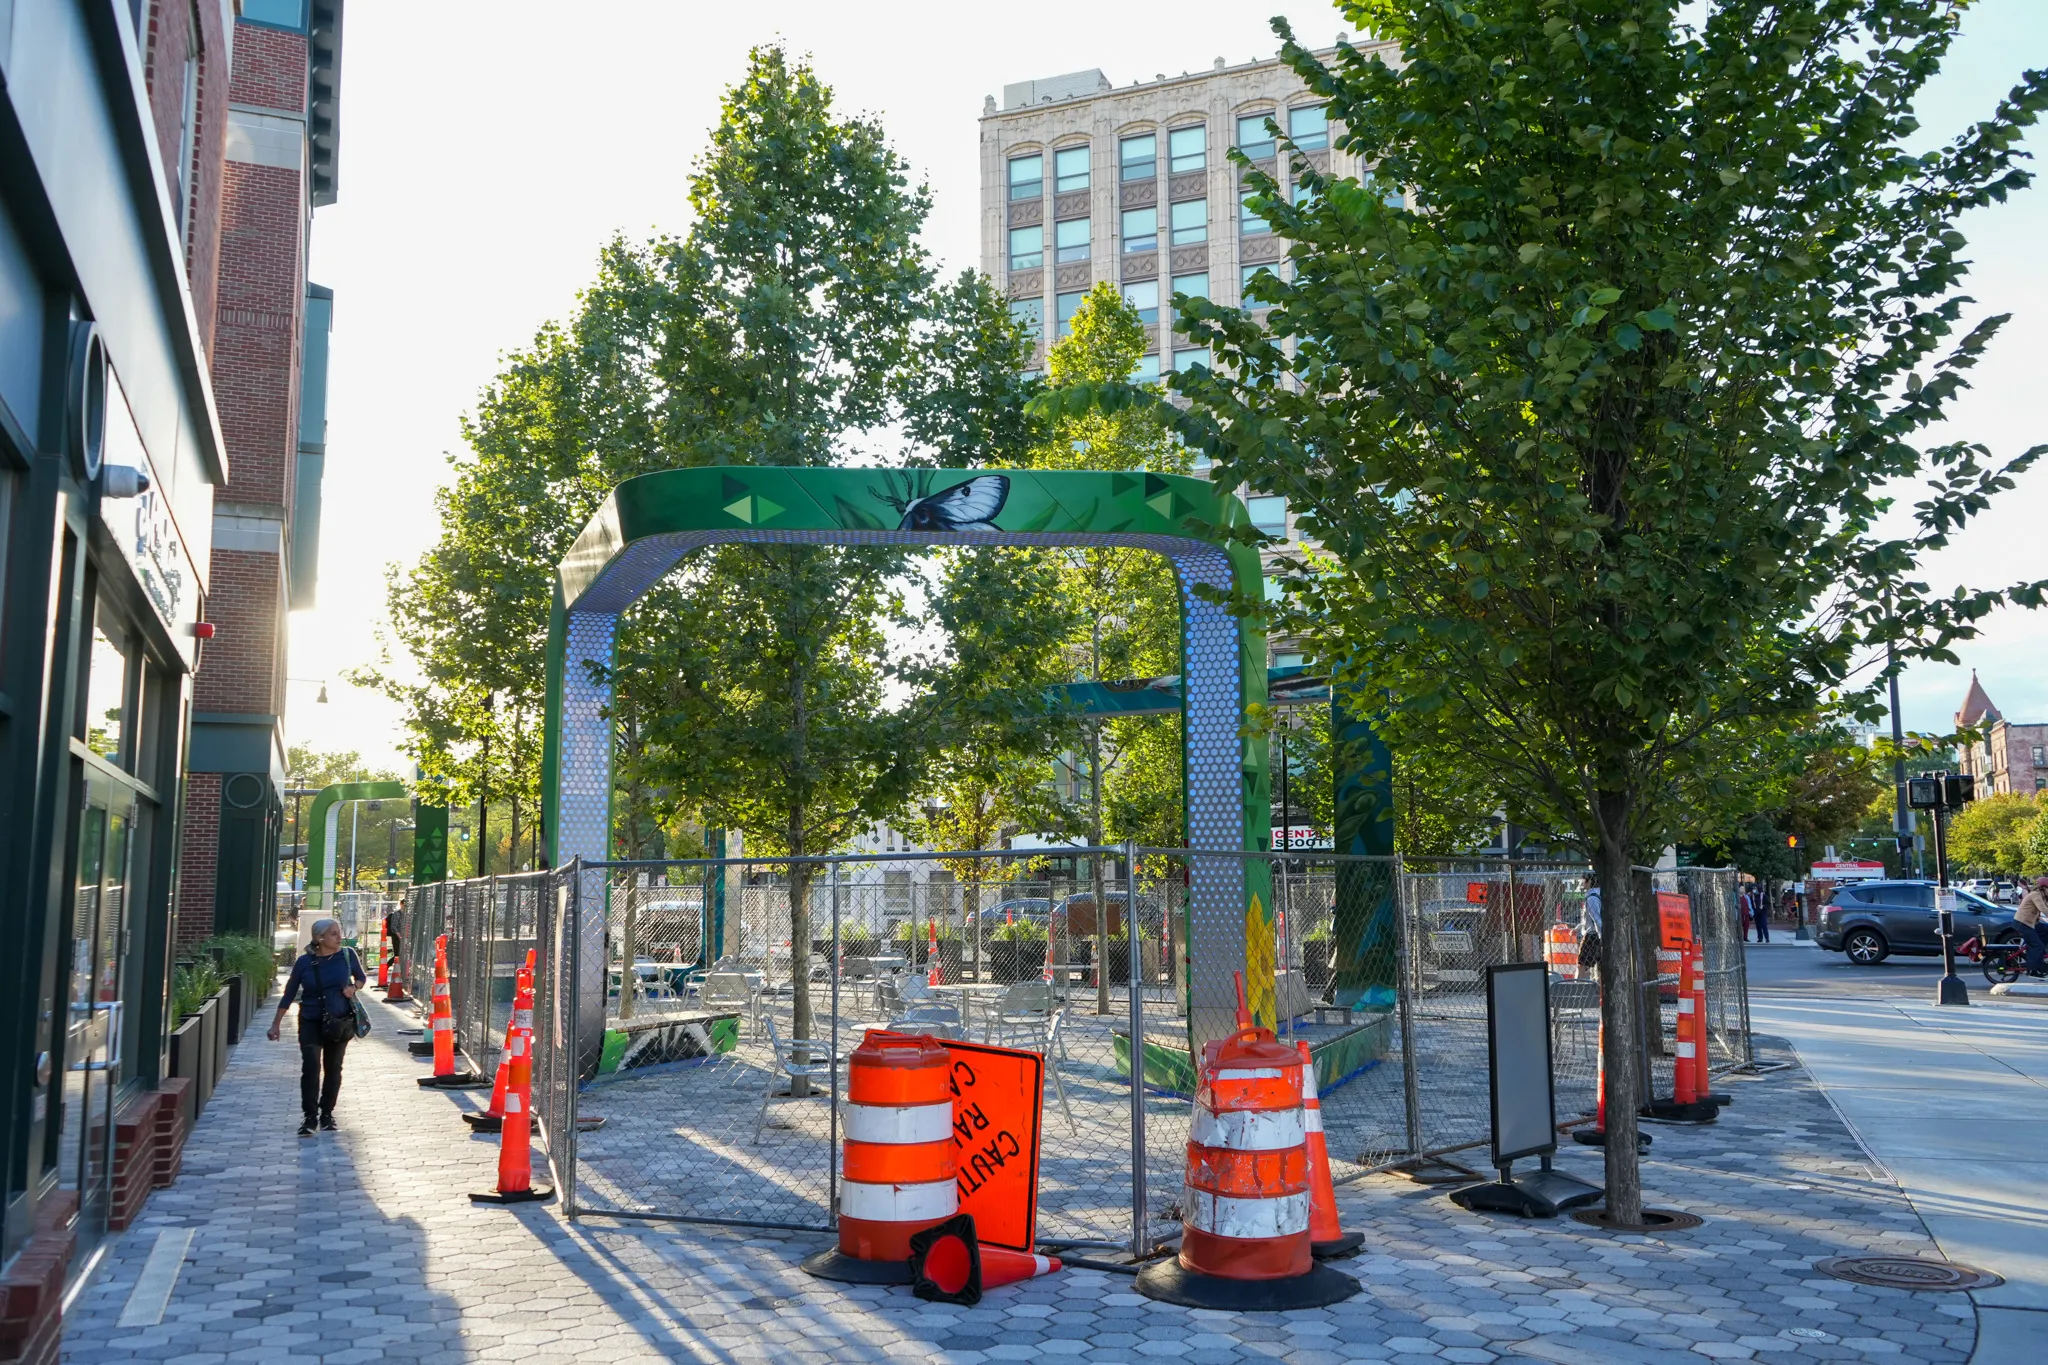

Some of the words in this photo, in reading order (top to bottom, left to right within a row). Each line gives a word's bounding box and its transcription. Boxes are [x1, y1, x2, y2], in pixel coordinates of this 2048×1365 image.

[1275, 829, 1321, 838] CENT
[1275, 838, 1332, 847] SCOOT
[950, 1061, 976, 1097] CA
[957, 1130, 1020, 1204] CAUTI
